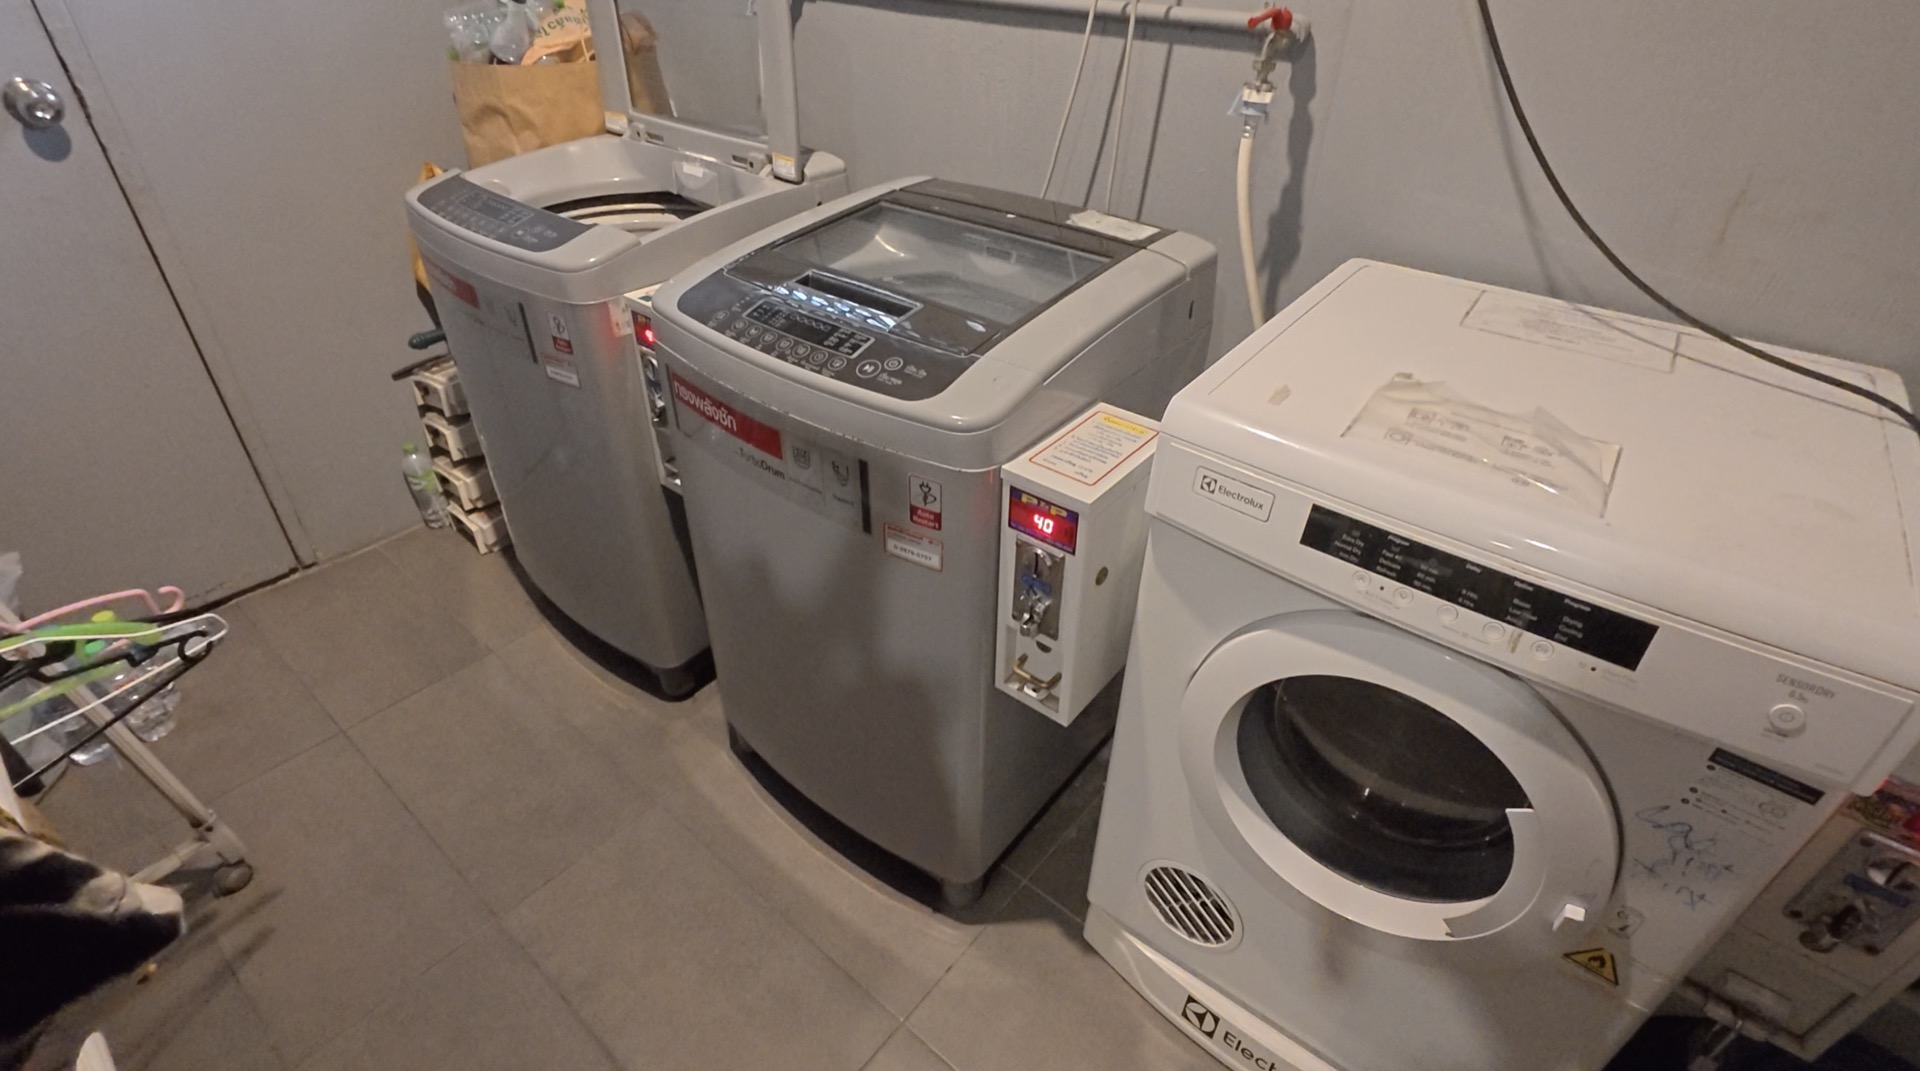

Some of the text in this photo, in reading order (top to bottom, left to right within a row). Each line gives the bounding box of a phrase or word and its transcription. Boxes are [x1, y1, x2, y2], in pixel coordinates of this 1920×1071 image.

[1218, 485, 1264, 510] Electrolux
[917, 509, 934, 520] Auto
[1033, 513, 1054, 534] 40
